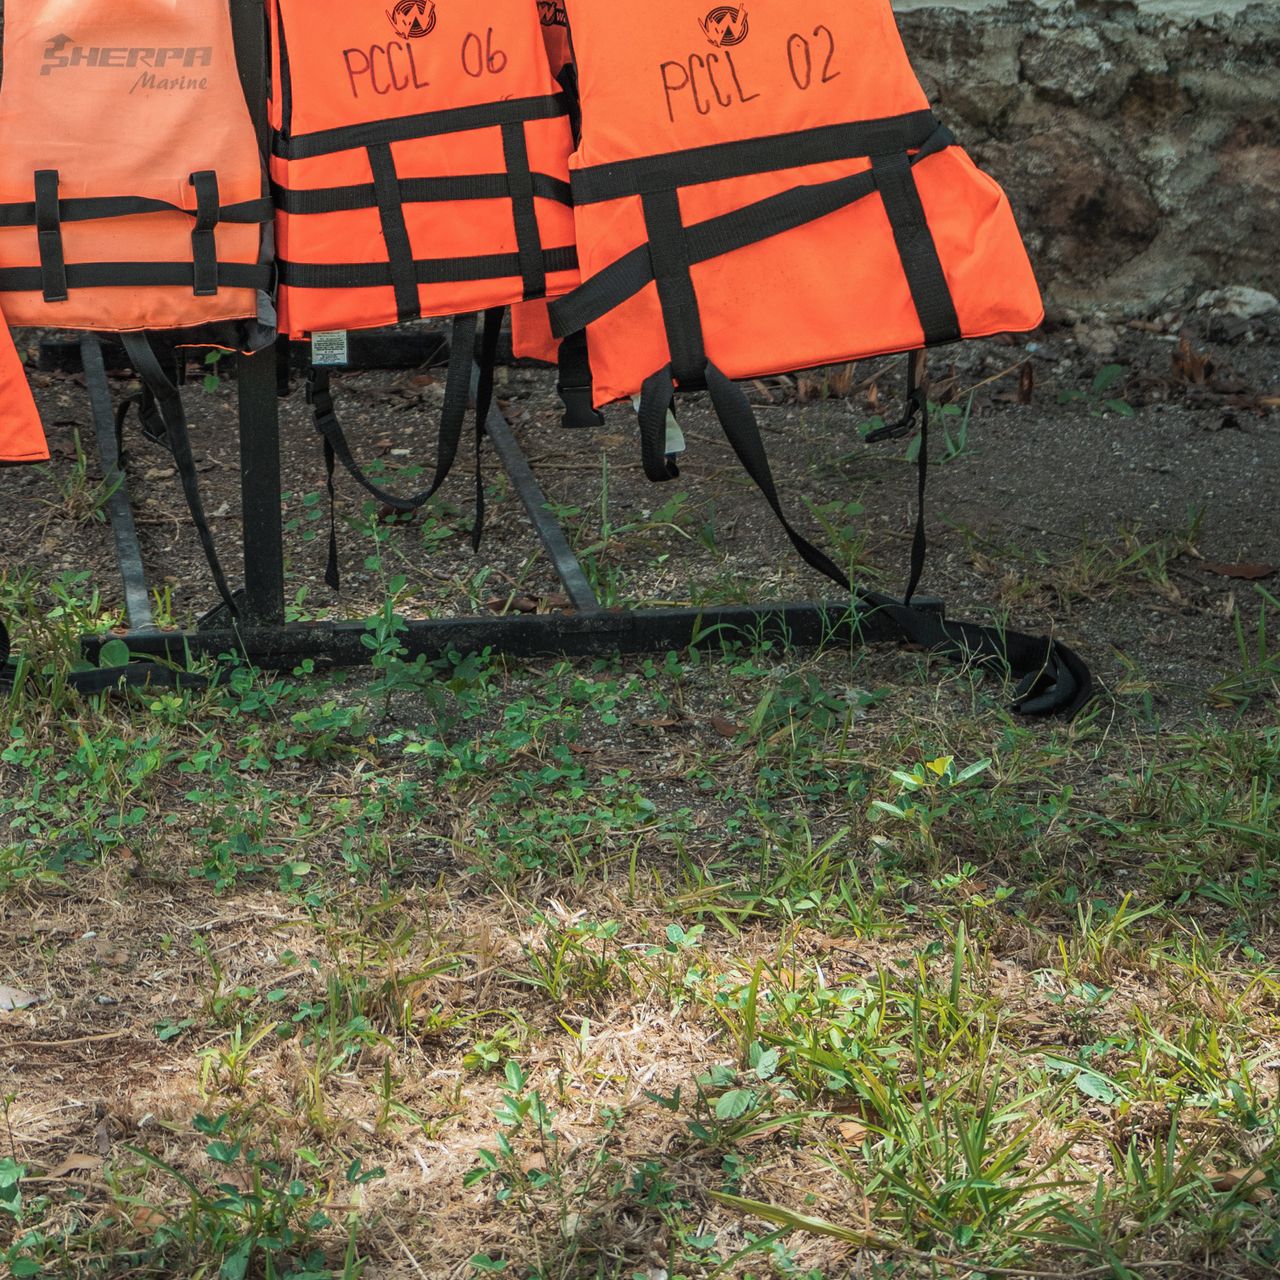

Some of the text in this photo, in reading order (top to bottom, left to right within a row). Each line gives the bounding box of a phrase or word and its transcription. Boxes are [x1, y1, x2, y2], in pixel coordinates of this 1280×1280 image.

[39, 33, 213, 76] SHERPA
[128, 71, 209, 95] Marine
[342, 27, 508, 99] PCCL 06
[659, 24, 841, 123] PCCL 02
